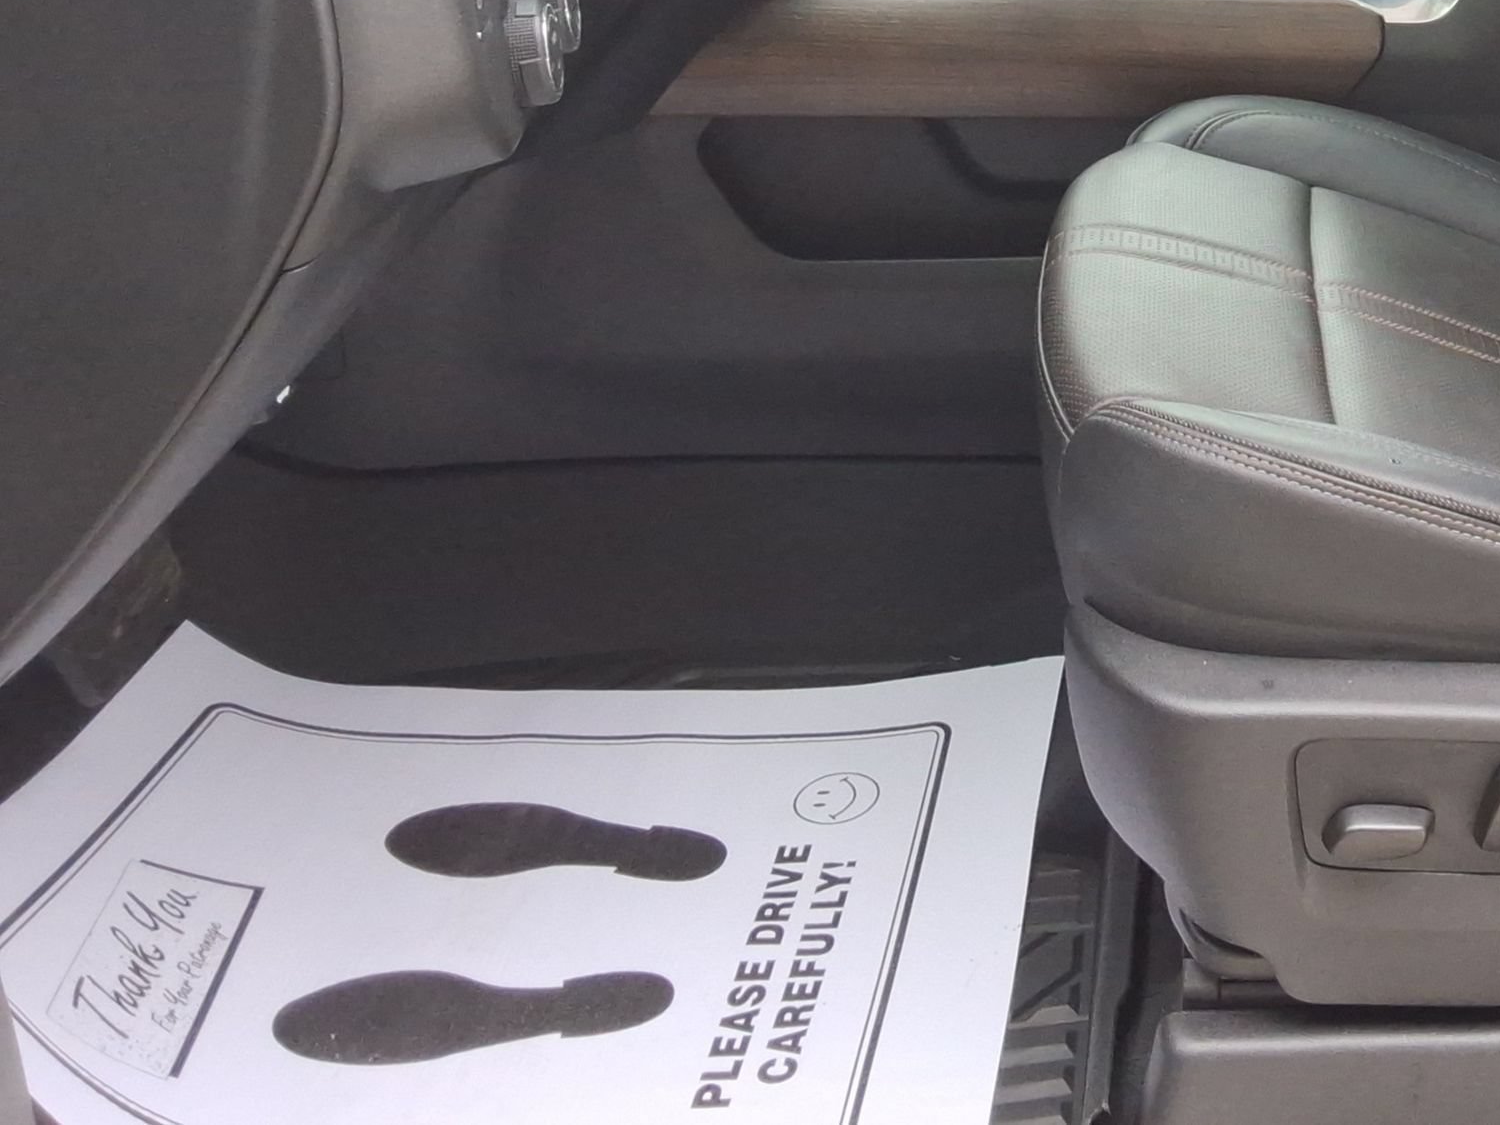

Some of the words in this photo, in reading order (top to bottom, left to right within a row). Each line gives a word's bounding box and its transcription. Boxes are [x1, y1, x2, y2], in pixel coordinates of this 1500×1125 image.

[72, 925, 165, 1039] Thank
[123, 888, 200, 935] You
[691, 960, 775, 1109] PLEASE
[746, 844, 812, 946] DRIVE
[757, 860, 857, 1085] CAREFULLY!
